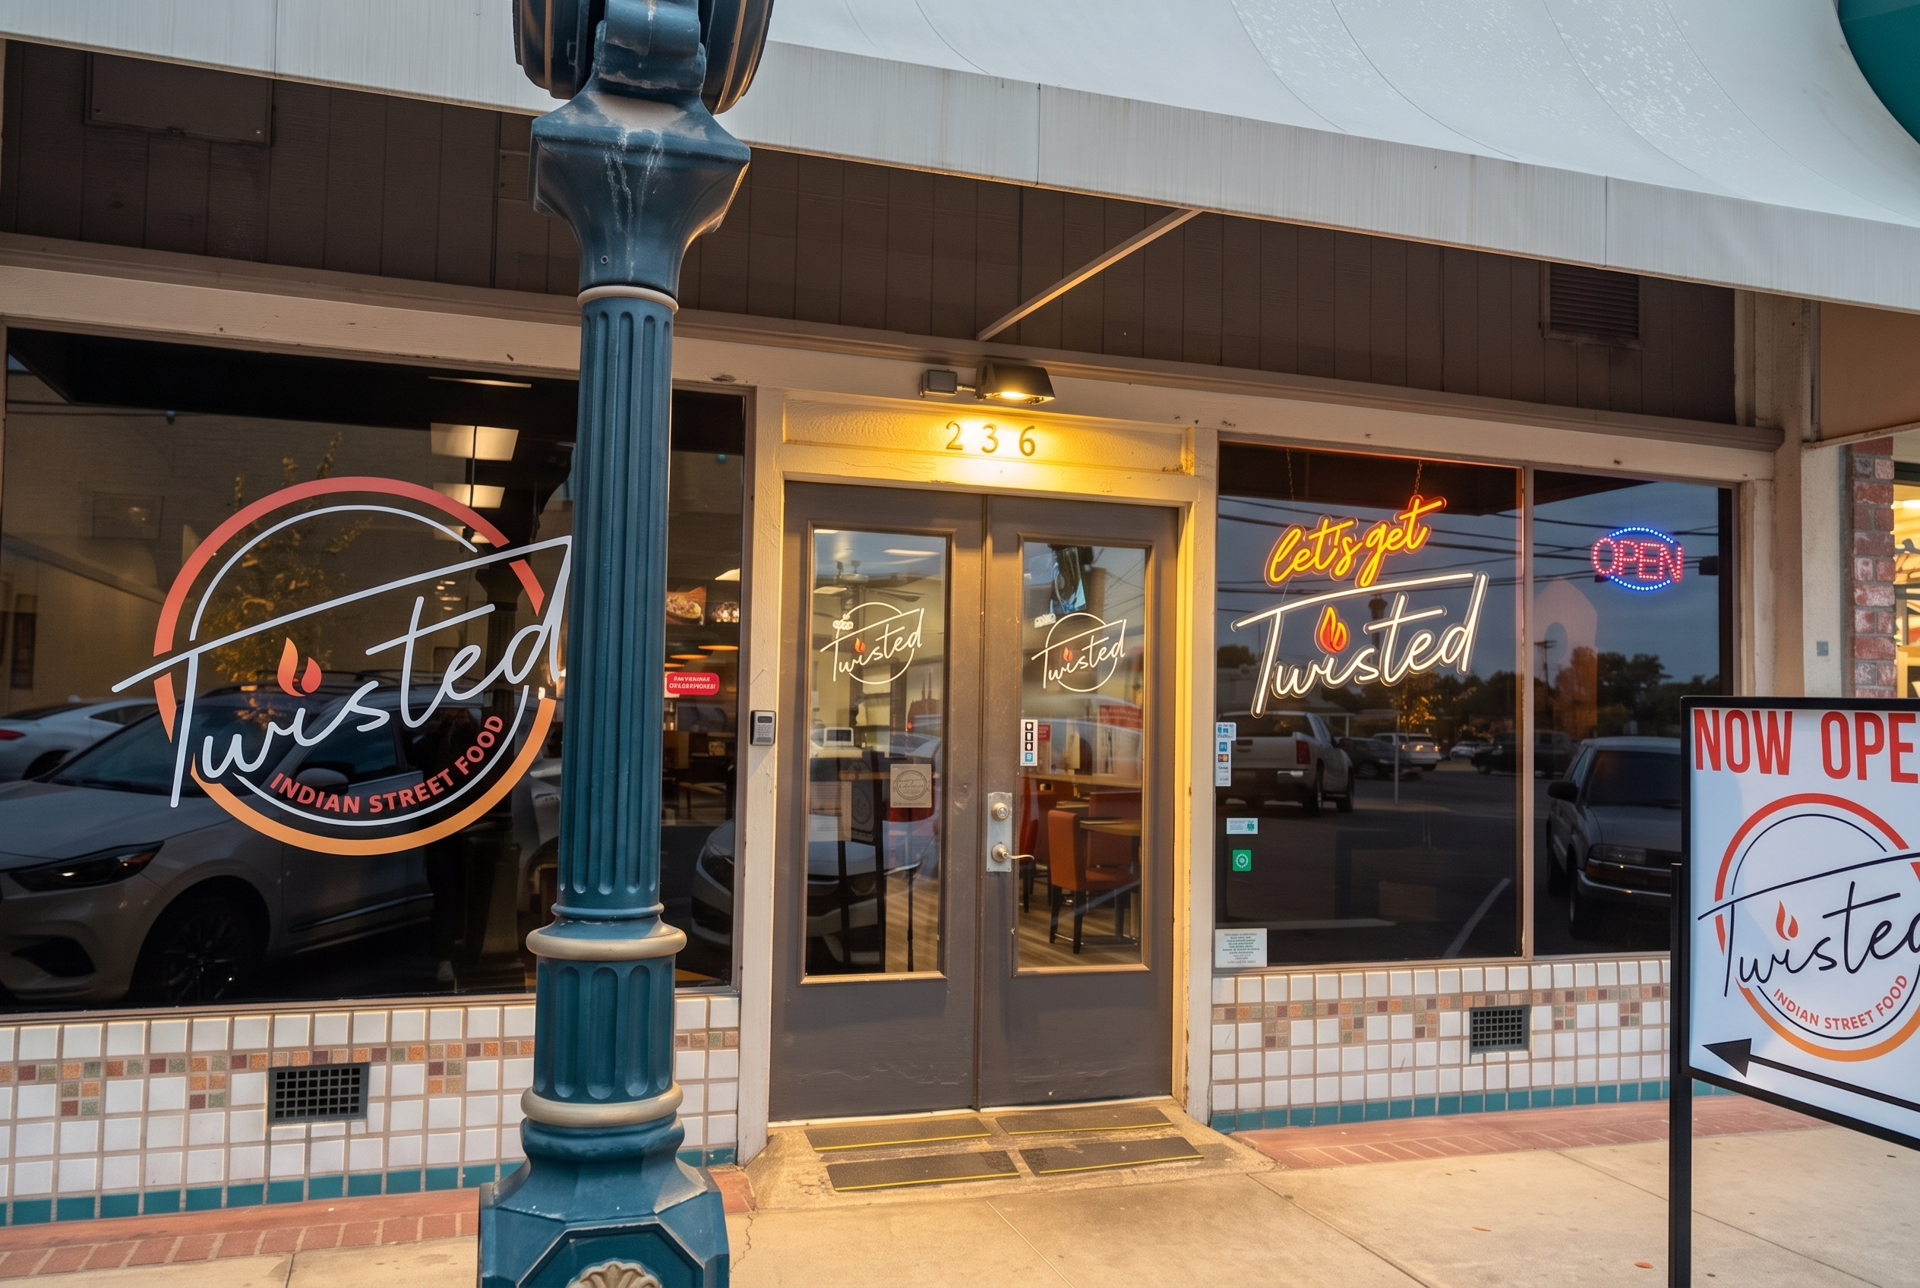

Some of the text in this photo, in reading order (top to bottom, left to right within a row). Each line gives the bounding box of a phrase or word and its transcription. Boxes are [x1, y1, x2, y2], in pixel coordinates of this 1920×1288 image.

[946, 420, 1036, 457] 236
[1269, 498, 1443, 588] let's get
[1591, 537, 1683, 583] OPEN
[112, 536, 572, 808] Twisted
[820, 607, 925, 682] Twisted
[1031, 618, 1127, 689] Twisted
[1234, 571, 1486, 716] Twisted
[269, 715, 504, 814] INDIAN STREET FOOD
[1693, 708, 1793, 776] NOW
[1773, 974, 1908, 1031] INDIAN STREET FOOD
